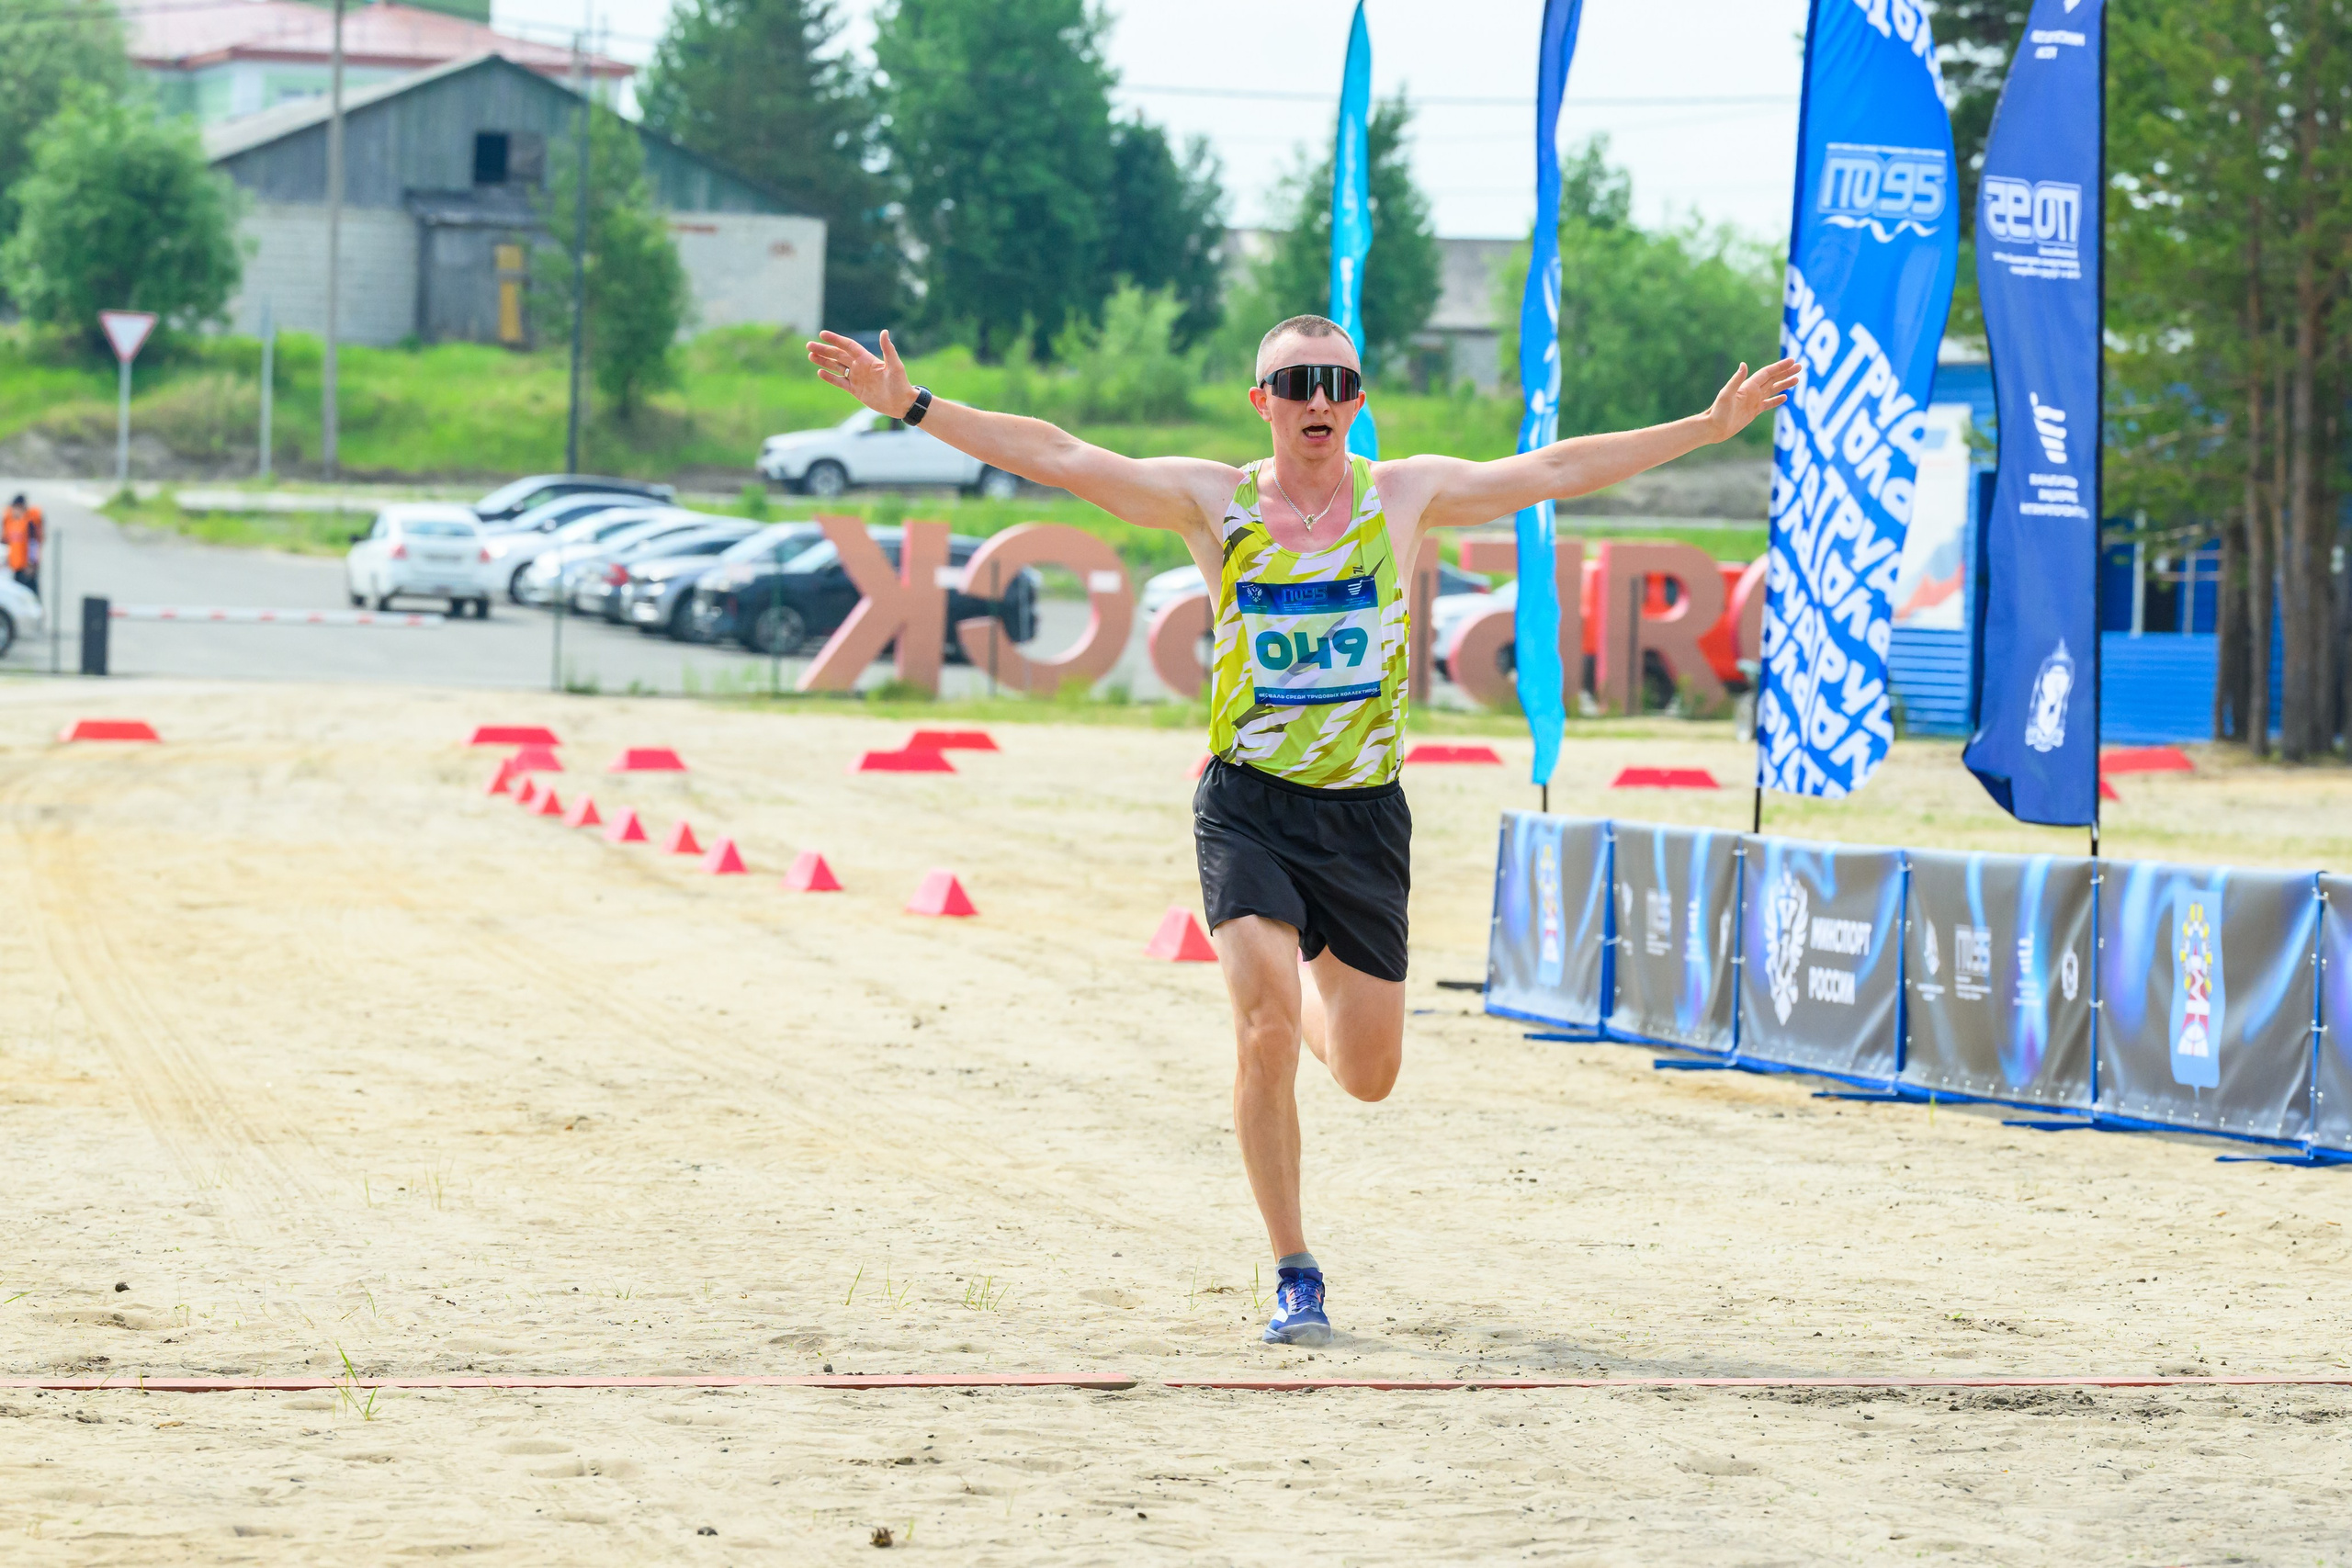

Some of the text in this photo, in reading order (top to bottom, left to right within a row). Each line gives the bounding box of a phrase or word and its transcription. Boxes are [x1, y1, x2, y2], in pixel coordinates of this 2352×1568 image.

[1255, 626, 1369, 671] 049
[1811, 916, 1871, 956] МИНСПОРТ
[1809, 965, 1856, 1005] РОССИИ
